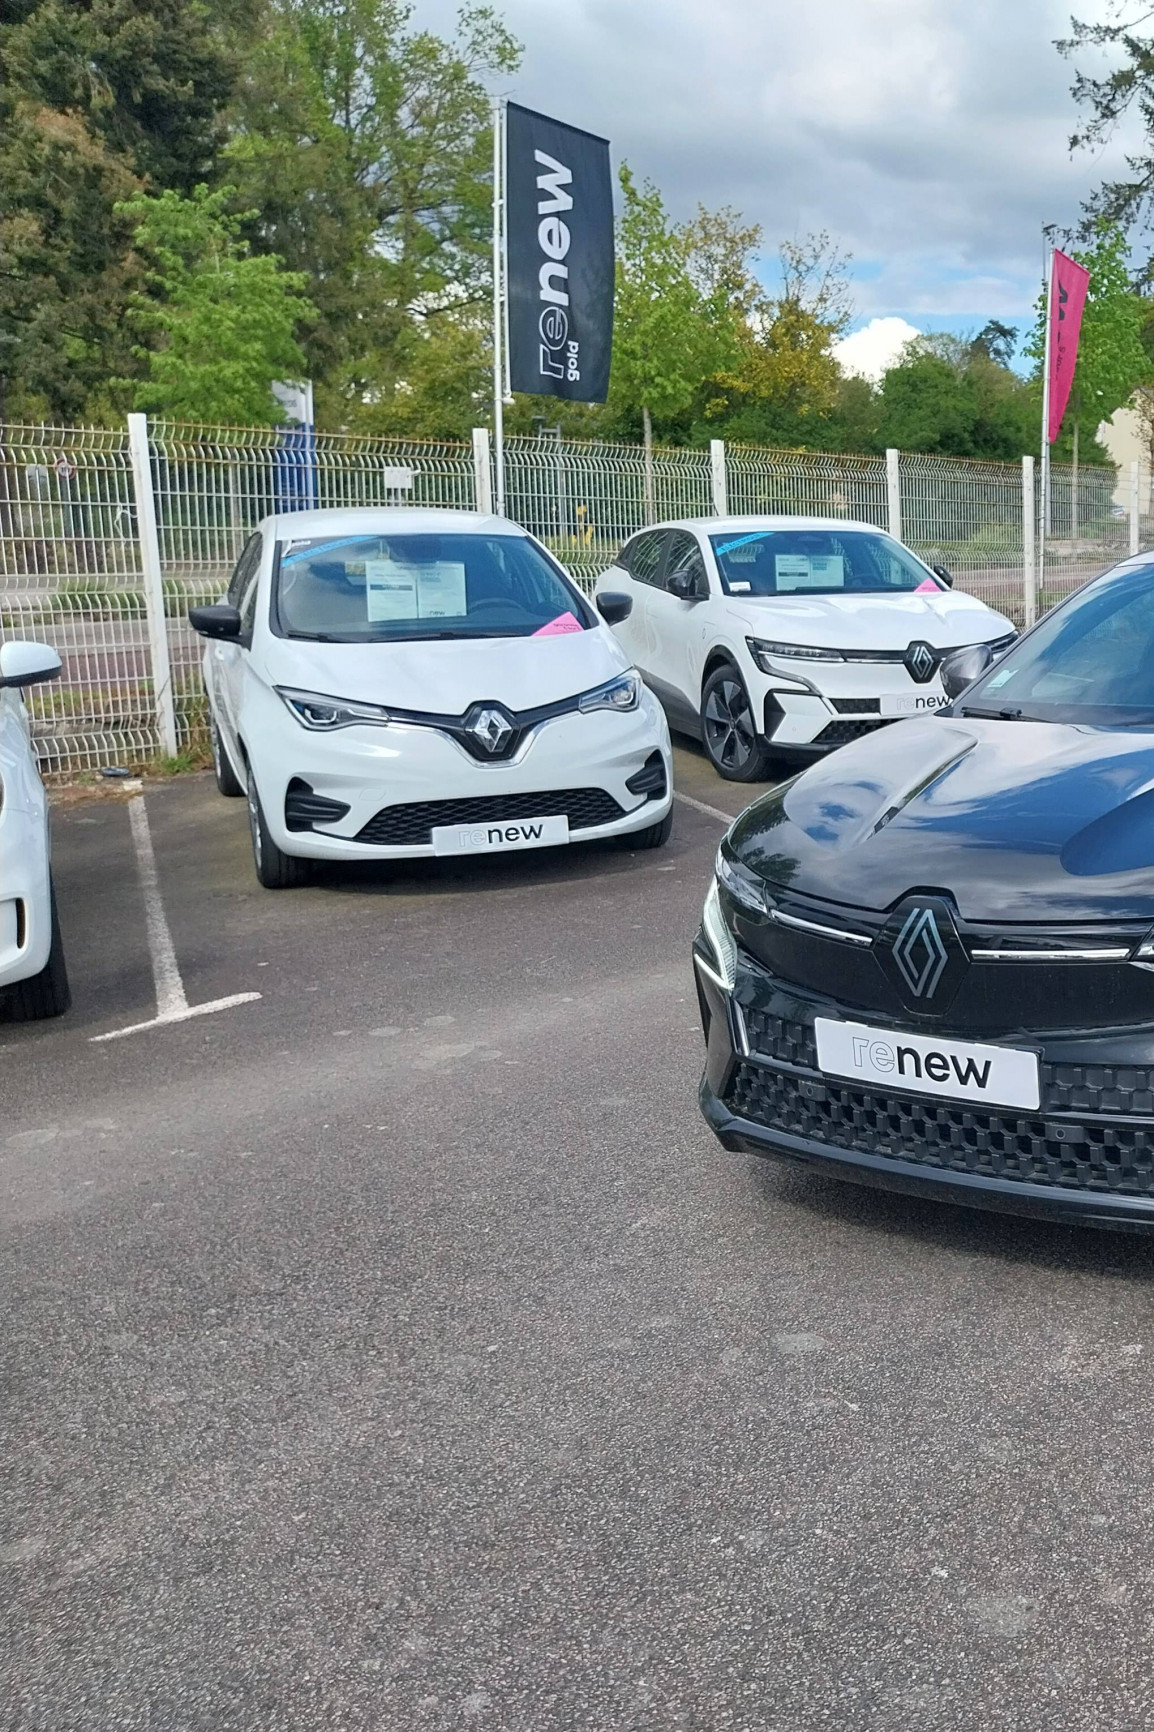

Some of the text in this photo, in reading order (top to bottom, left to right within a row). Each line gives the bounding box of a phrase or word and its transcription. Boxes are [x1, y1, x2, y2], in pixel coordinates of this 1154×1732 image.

[533, 148, 575, 380] renew
[567, 340, 581, 382] gold
[896, 695, 951, 711] renew
[458, 824, 543, 848] renew
[852, 1036, 991, 1089] renew
